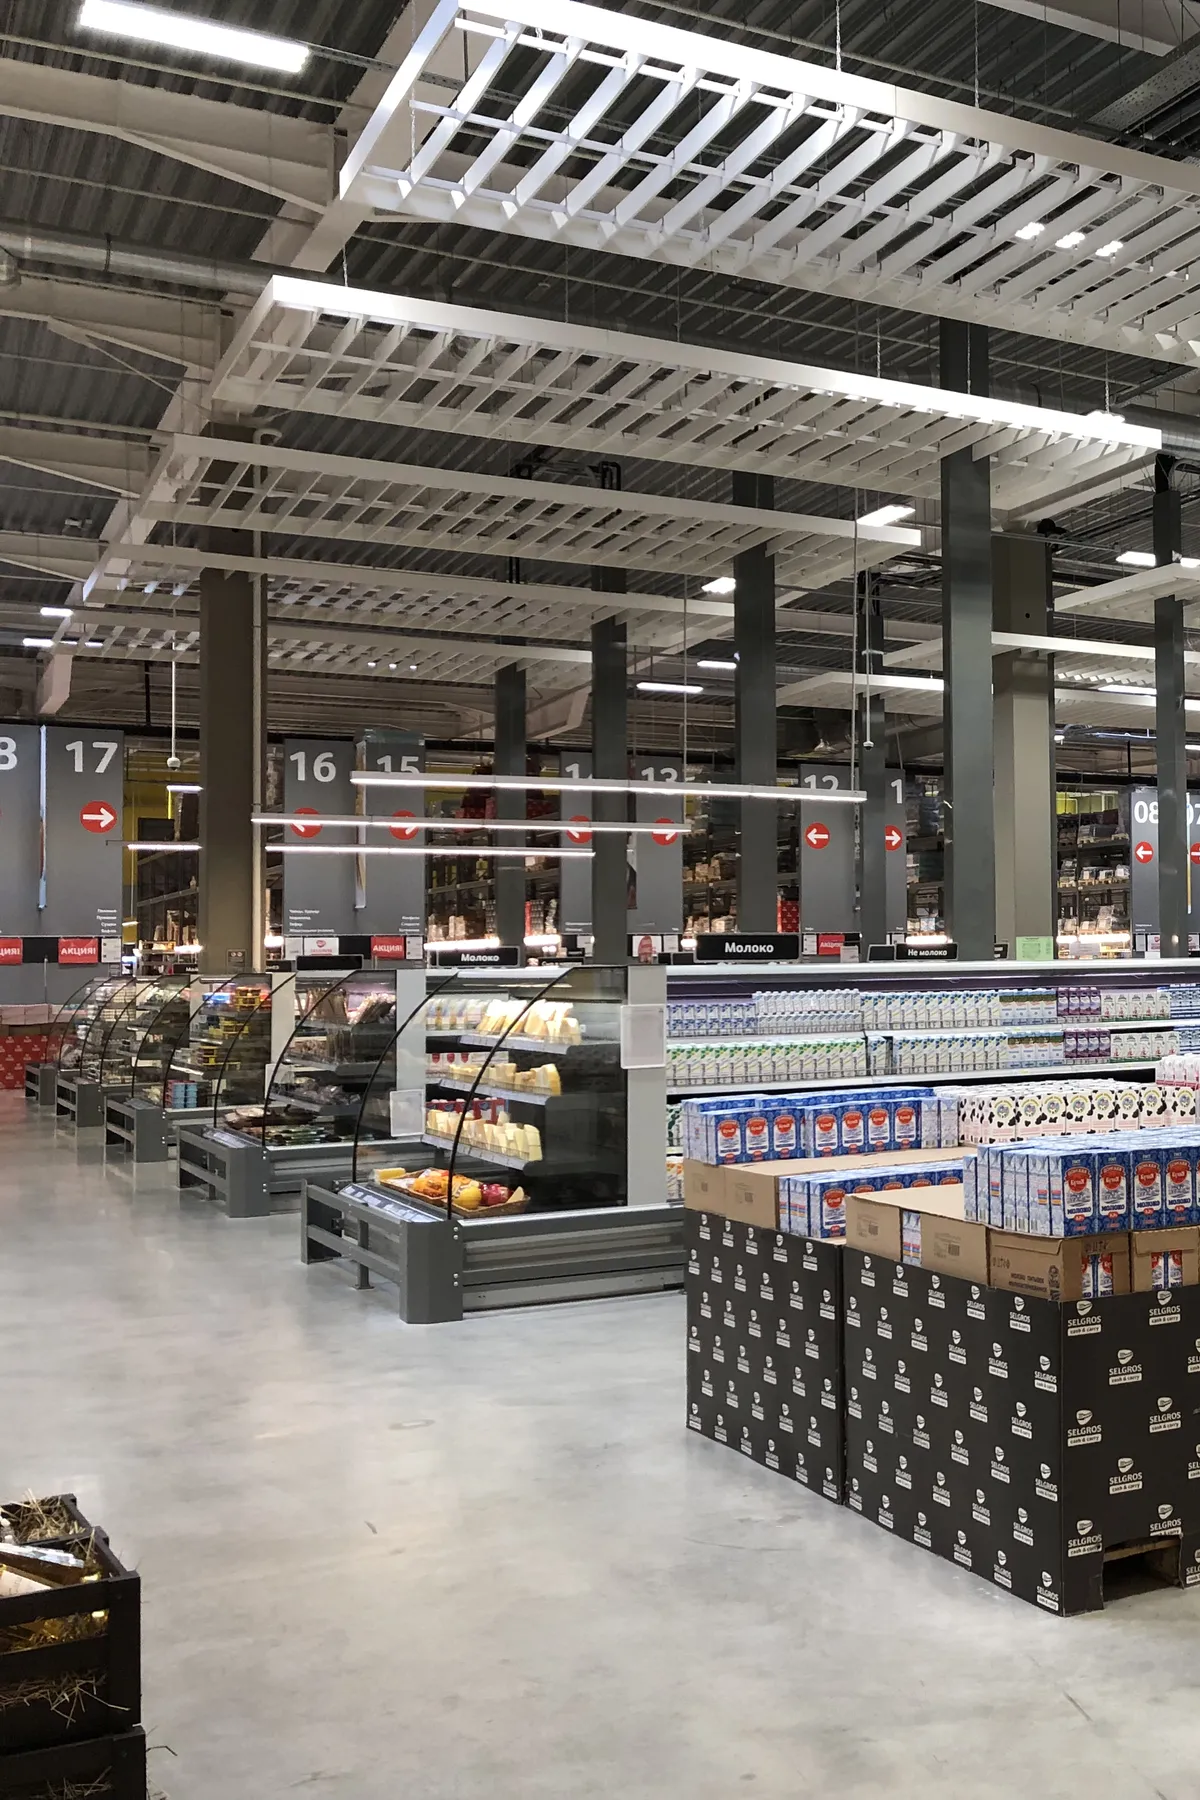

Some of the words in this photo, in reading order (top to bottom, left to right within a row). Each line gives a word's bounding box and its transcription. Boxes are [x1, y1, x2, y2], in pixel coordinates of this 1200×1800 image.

[65, 740, 118, 774] 17
[289, 751, 337, 783] 16
[60, 947, 96, 956] АКЦИЯ!
[373, 945, 403, 953] АКЦИЯ!
[725, 942, 774, 953] Молоко
[908, 949, 918, 957] Не
[461, 952, 500, 963] Молоко
[1149, 1306, 1180, 1316] SELGROS
[1010, 1312, 1030, 1323] SELGROS
[1068, 1316, 1101, 1327] SELGROS
[989, 1358, 1008, 1369] SELGROS
[1109, 1364, 1142, 1375] SELGROS
[1035, 1371, 1056, 1383] SELGROS
[1012, 1417, 1032, 1430] SELGROS
[1150, 1412, 1181, 1424] SELGROS
[1068, 1425, 1101, 1437] SELGROS
[991, 1461, 1010, 1474] SELGROS
[1110, 1472, 1142, 1485] SELGROS
[1035, 1478, 1058, 1492] SELGROS
[1150, 1518, 1181, 1531] SELGROS
[1068, 1534, 1102, 1547] SELGROS
[1037, 1586, 1058, 1598] SELGROS
